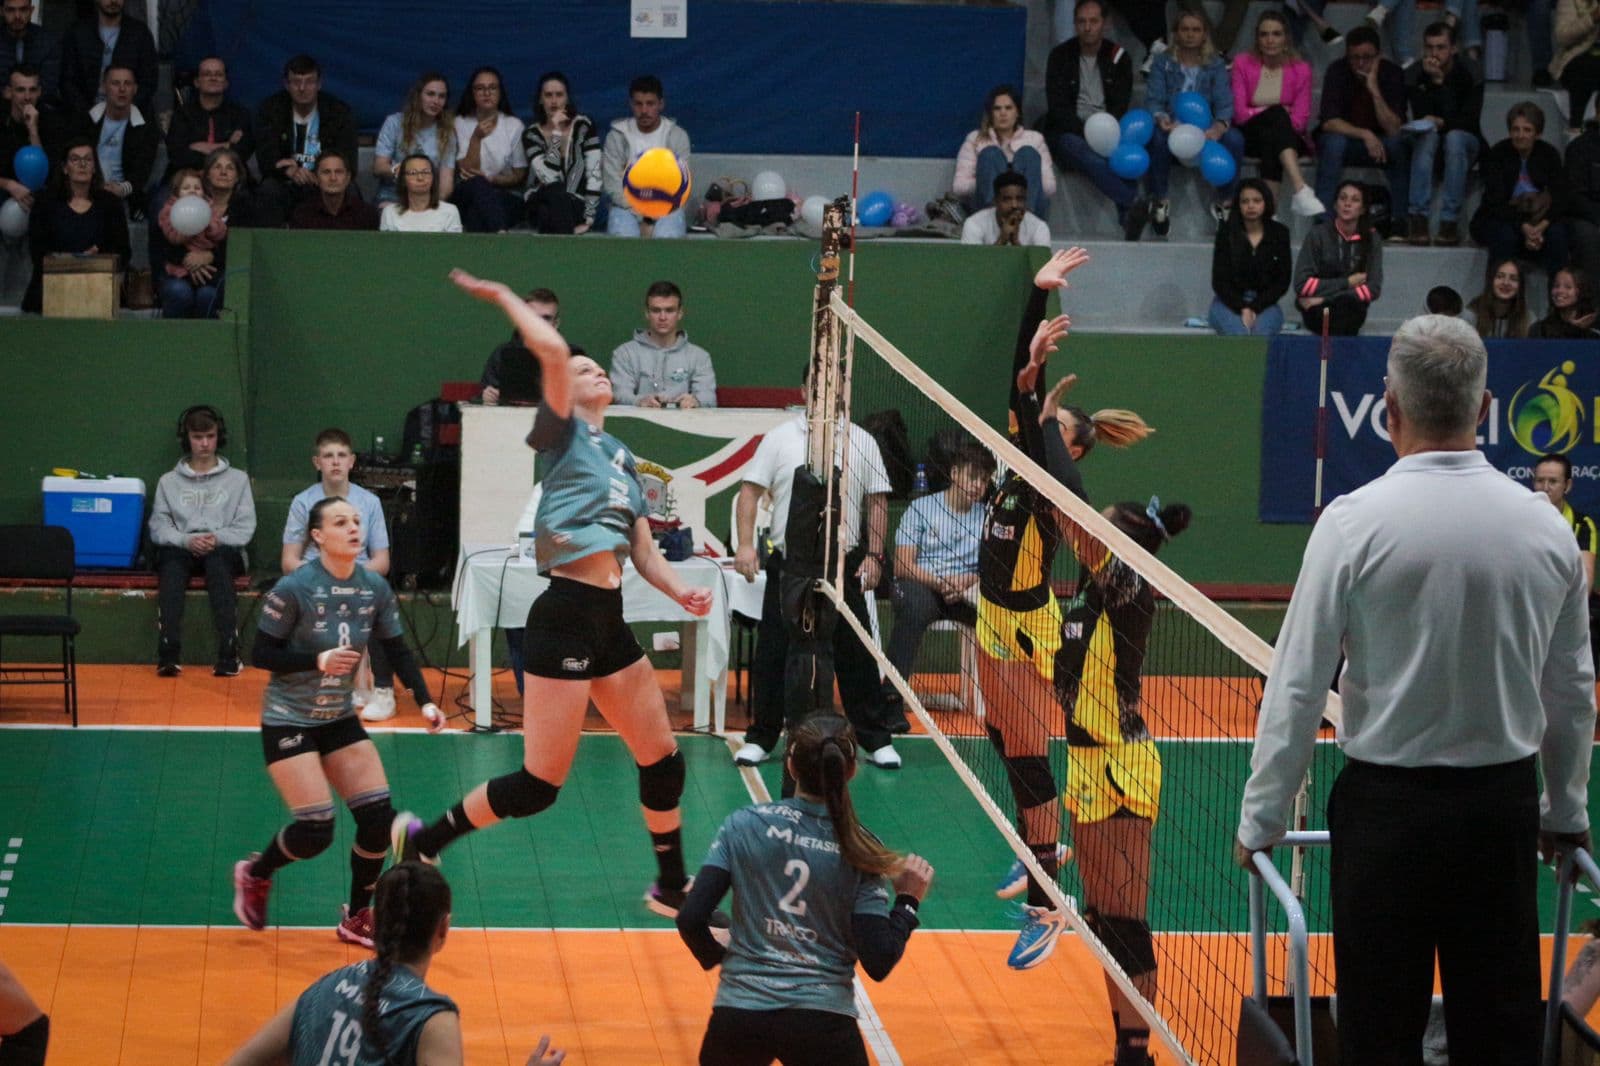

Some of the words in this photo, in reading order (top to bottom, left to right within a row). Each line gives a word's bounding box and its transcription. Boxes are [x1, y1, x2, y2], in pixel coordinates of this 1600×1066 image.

[338, 622, 350, 647] 8
[779, 859, 810, 917] 2
[316, 1010, 363, 1066] 19
